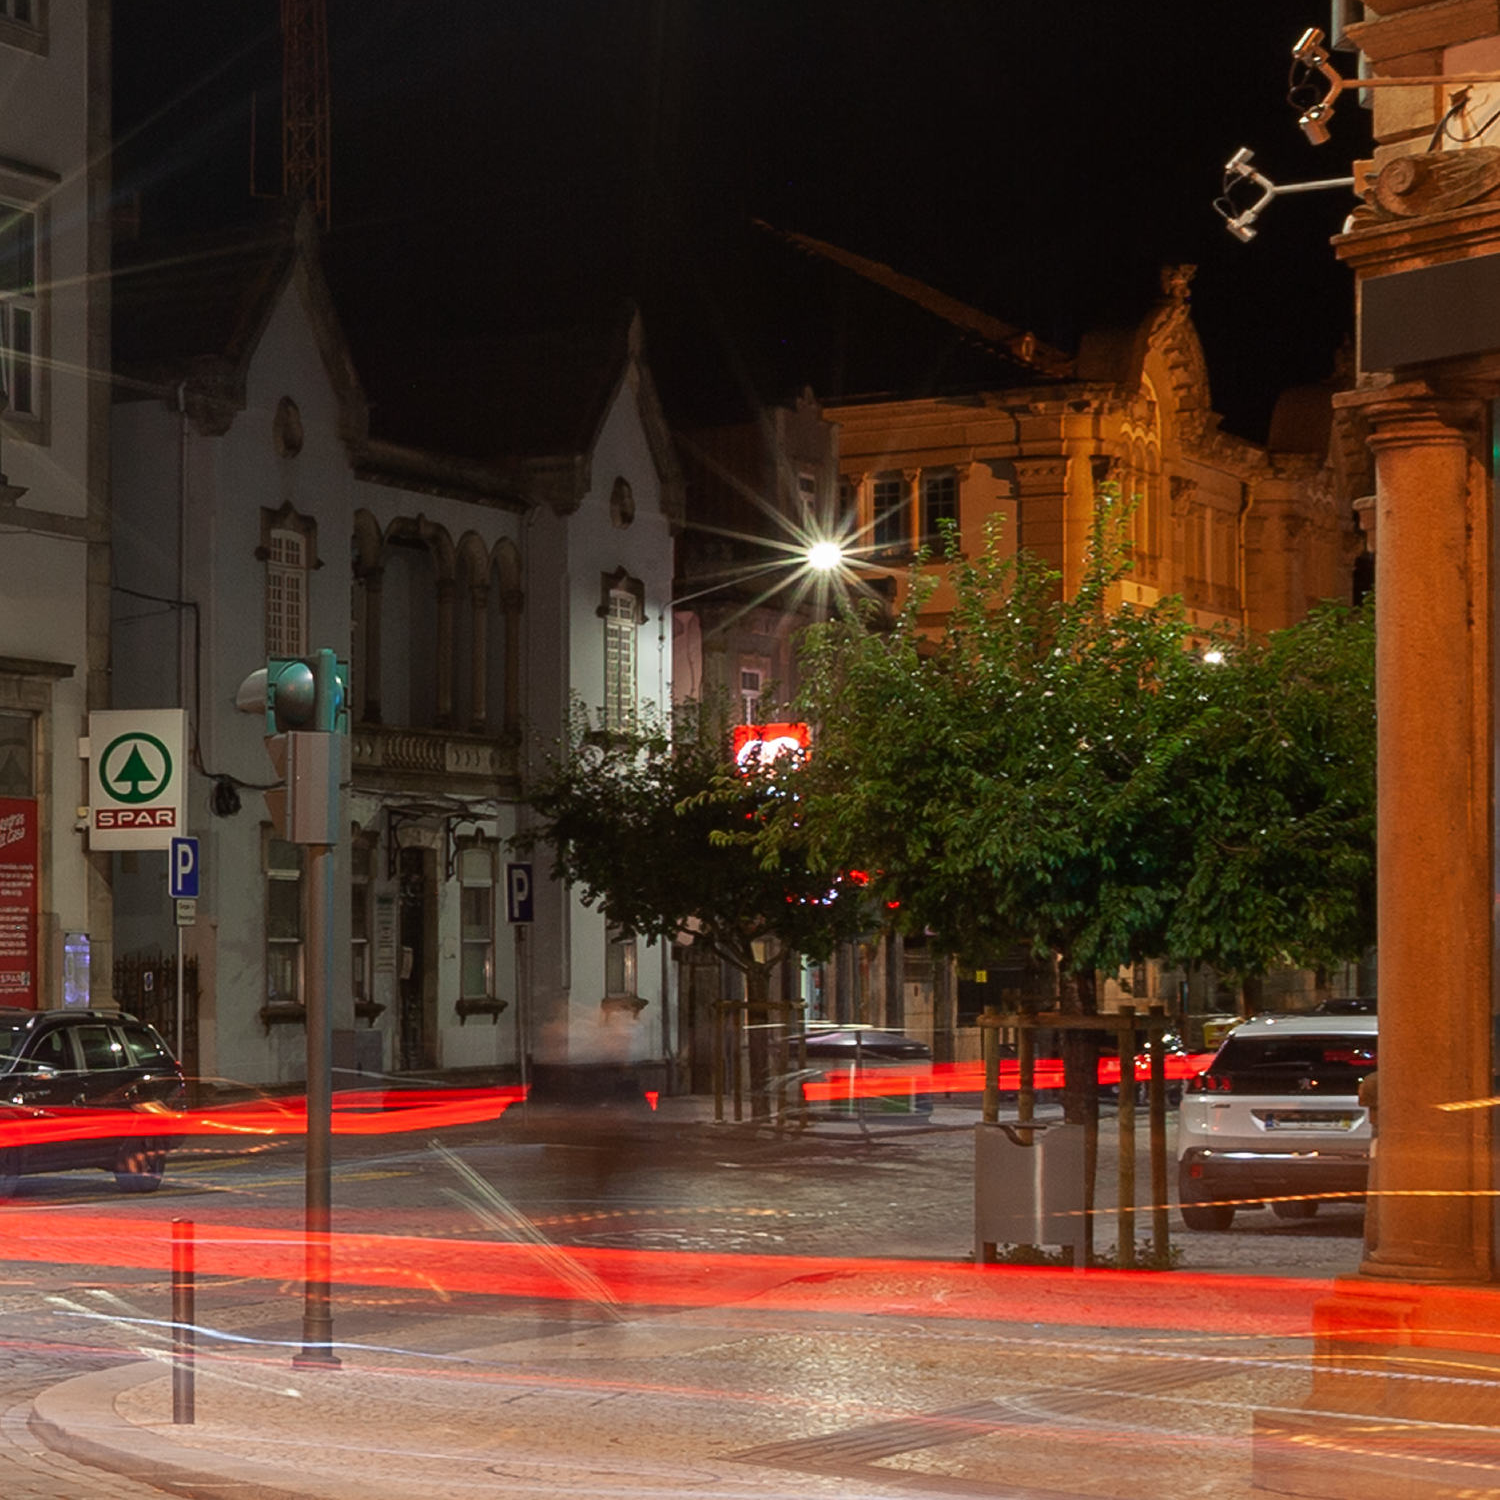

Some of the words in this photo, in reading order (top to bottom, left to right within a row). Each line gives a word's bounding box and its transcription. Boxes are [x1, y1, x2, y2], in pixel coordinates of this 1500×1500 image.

[98, 810, 174, 826] SPAR
[177, 843, 194, 891] P
[511, 869, 529, 918] P
